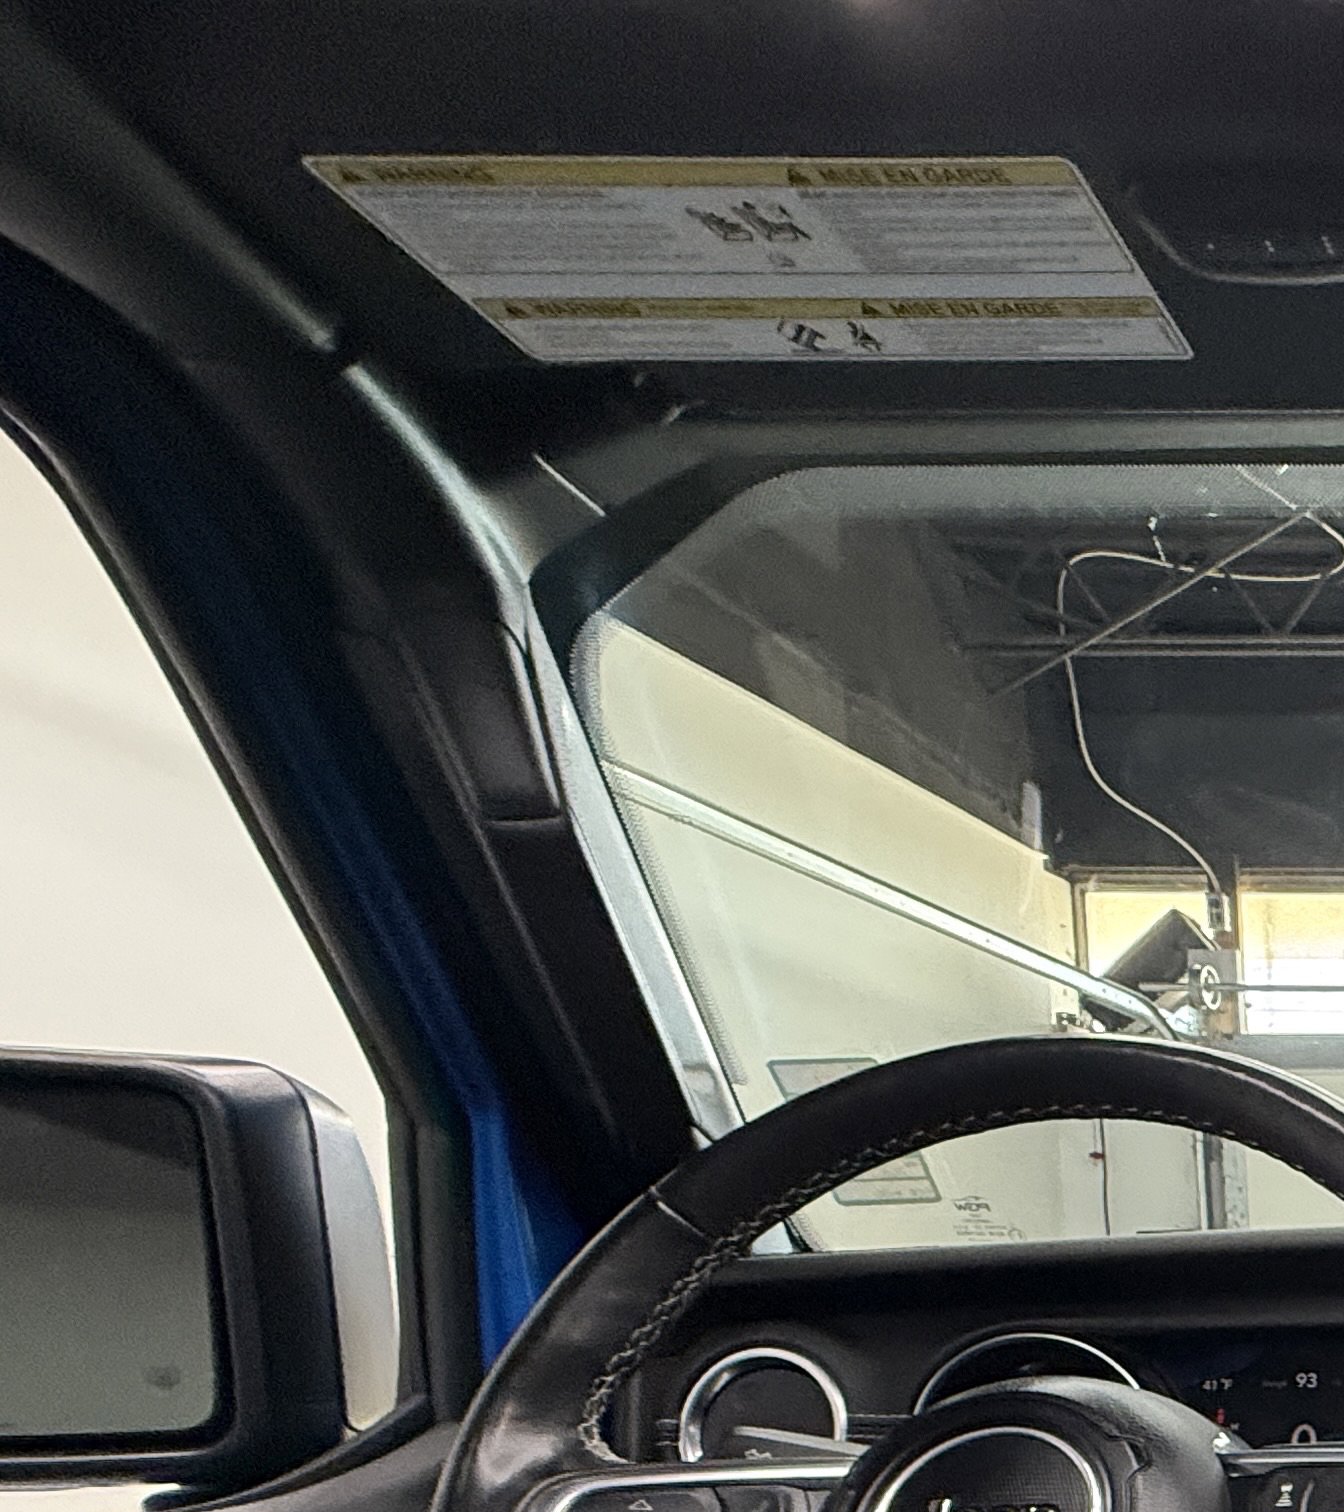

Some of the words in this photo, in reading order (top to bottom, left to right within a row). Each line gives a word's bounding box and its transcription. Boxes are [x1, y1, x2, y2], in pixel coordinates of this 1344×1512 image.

[883, 164, 920, 185] EN
[921, 164, 1012, 185] GARDE
[945, 301, 980, 317] EN
[983, 301, 1062, 317] GARDE
[1295, 1372, 1319, 1389] 93
